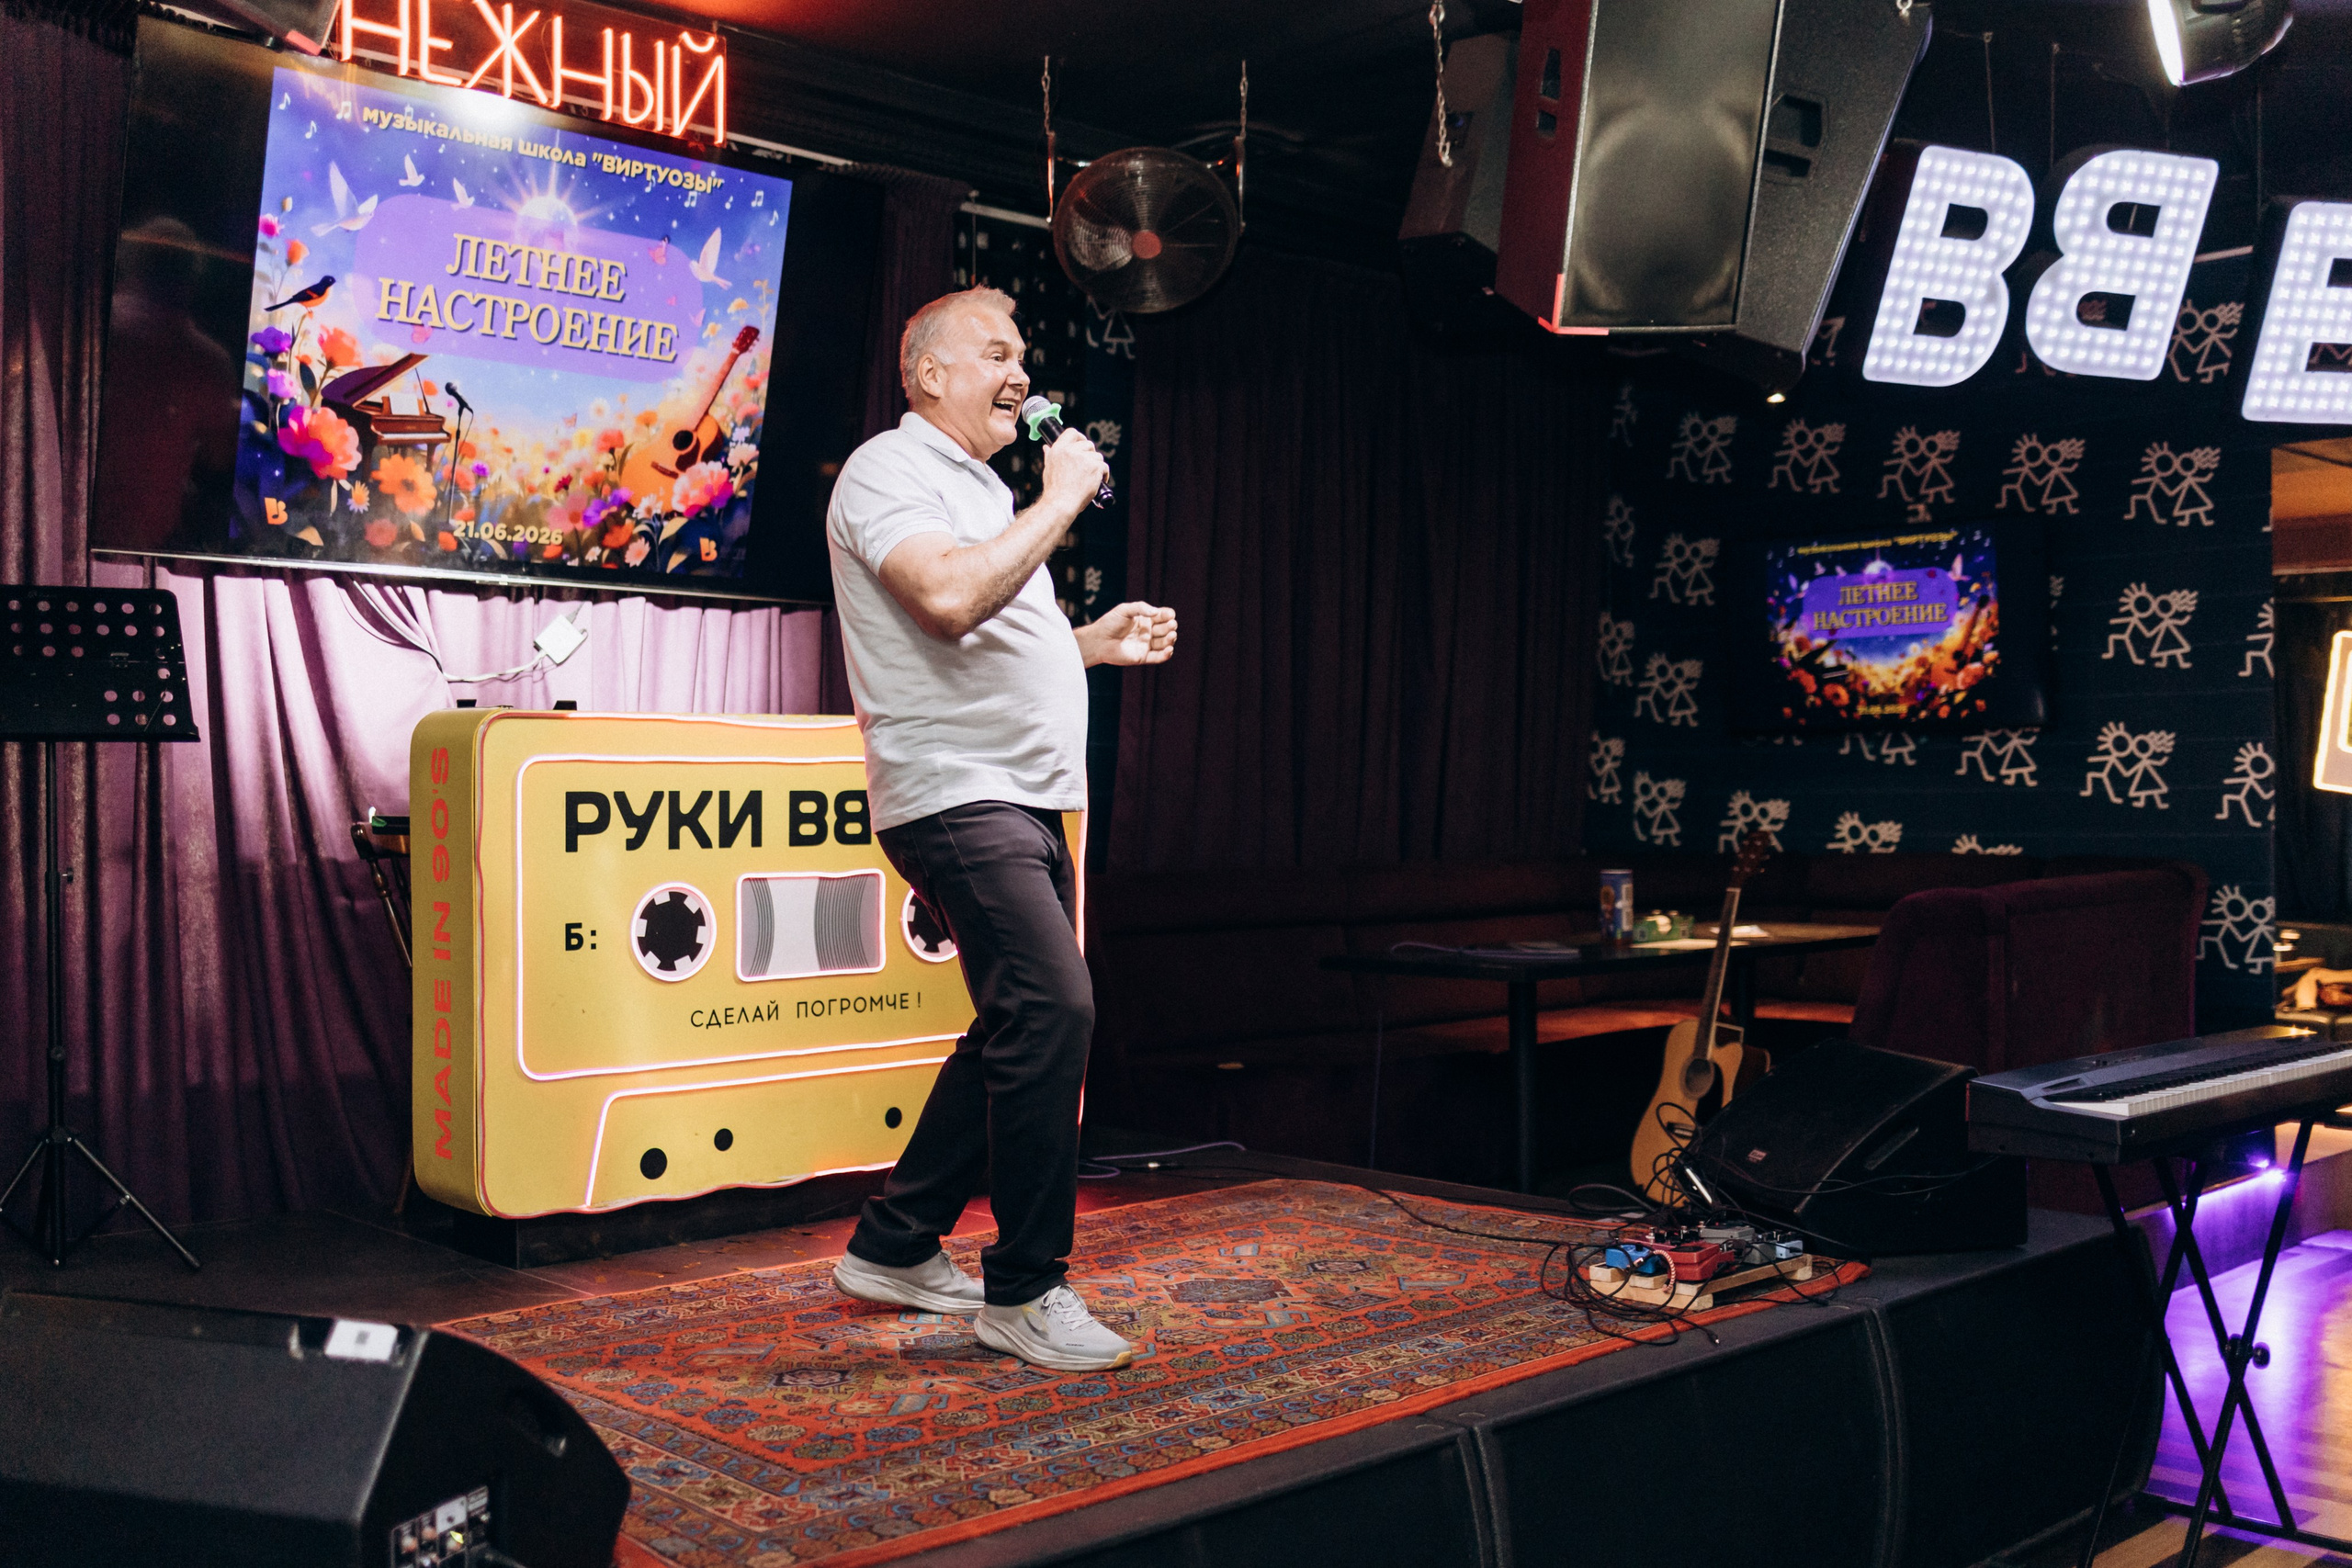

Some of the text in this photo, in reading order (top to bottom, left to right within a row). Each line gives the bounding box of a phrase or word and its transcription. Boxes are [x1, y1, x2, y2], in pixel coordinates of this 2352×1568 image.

[339, 0, 726, 146] НЕЖНЫЙ
[362, 106, 724, 195] музыкальная школа "ВИРТУОЗЫ"
[446, 232, 627, 302] ЛЕТНЕЕ
[375, 276, 678, 363] НАСТРОЕНИЕ
[453, 520, 564, 546] 21.06.2026
[1813, 603, 1949, 631] НАСТРОЕНИЕ
[1838, 581, 1918, 606] ЛЕТНЕЕ
[565, 790, 763, 852] РУКИ
[430, 747, 453, 1161] MADE IN 90'S
[564, 922, 597, 952] Б:
[690, 999, 780, 1030] СДЕЛАЙ
